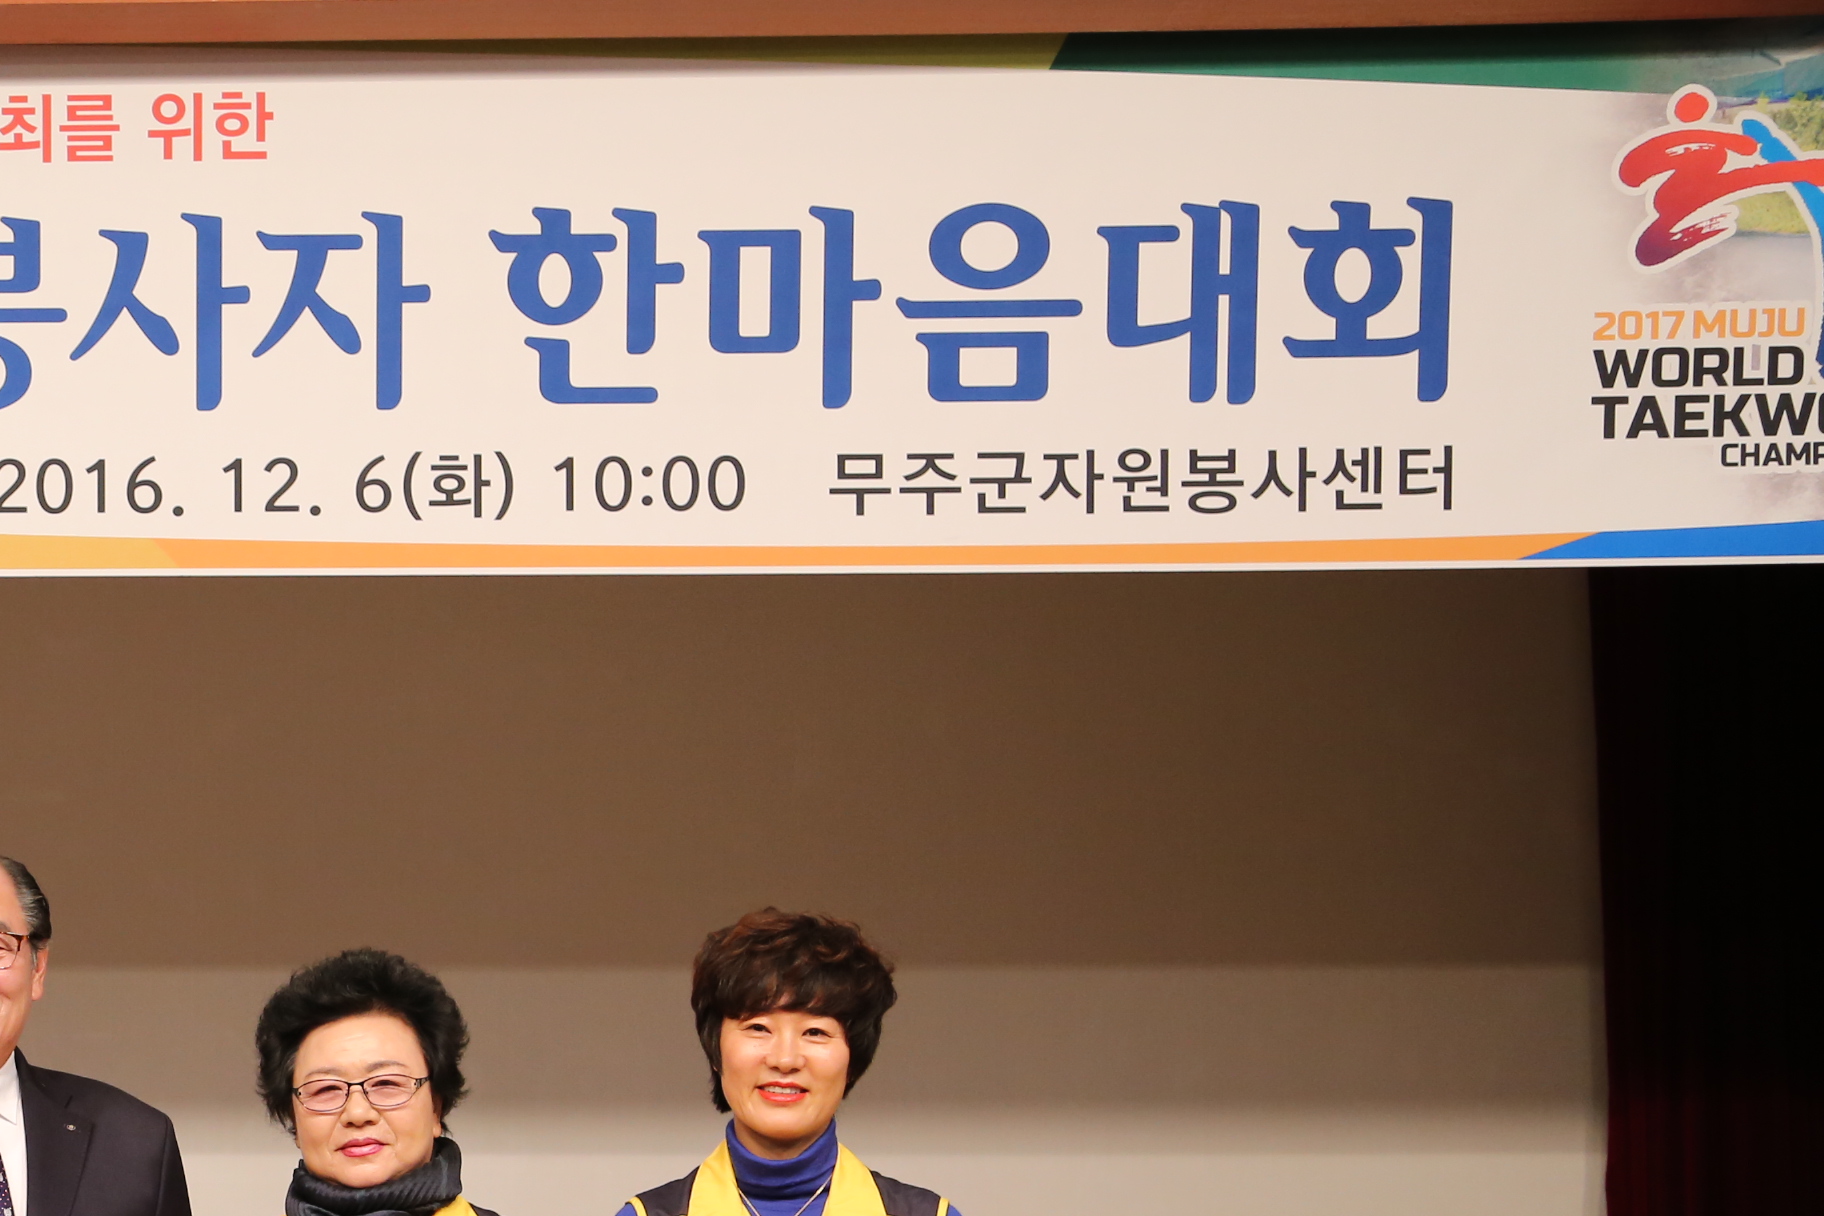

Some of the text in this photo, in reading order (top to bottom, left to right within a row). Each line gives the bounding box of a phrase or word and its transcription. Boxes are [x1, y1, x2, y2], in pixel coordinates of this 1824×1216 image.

[147, 91, 274, 162] 위한
[488, 196, 1454, 409] 한마음대회
[1592, 307, 1806, 341] 2017 MUJU
[1592, 345, 1805, 389] WORLD
[1591, 392, 1824, 440] TAEKW
[222, 457, 322, 517] 12.
[355, 451, 514, 521] 6(화)
[554, 455, 746, 512] 10:00
[829, 445, 1453, 516] 무주군자원봉사센터
